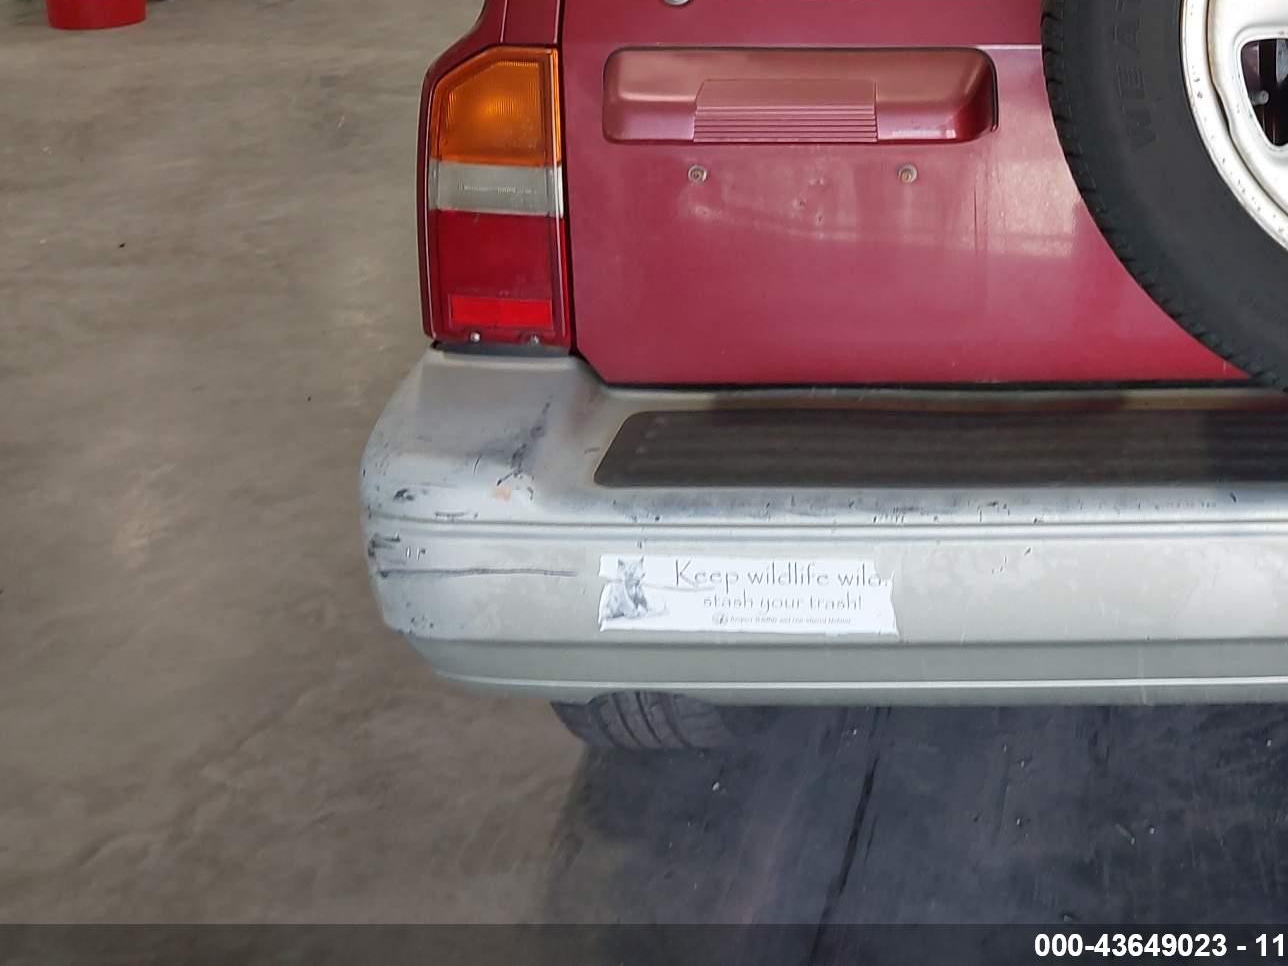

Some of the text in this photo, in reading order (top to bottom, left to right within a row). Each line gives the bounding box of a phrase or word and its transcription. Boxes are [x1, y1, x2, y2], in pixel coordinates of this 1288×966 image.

[675, 559, 739, 594] Keep
[748, 561, 830, 587] wildlife
[703, 588, 862, 613] stash your trash!
